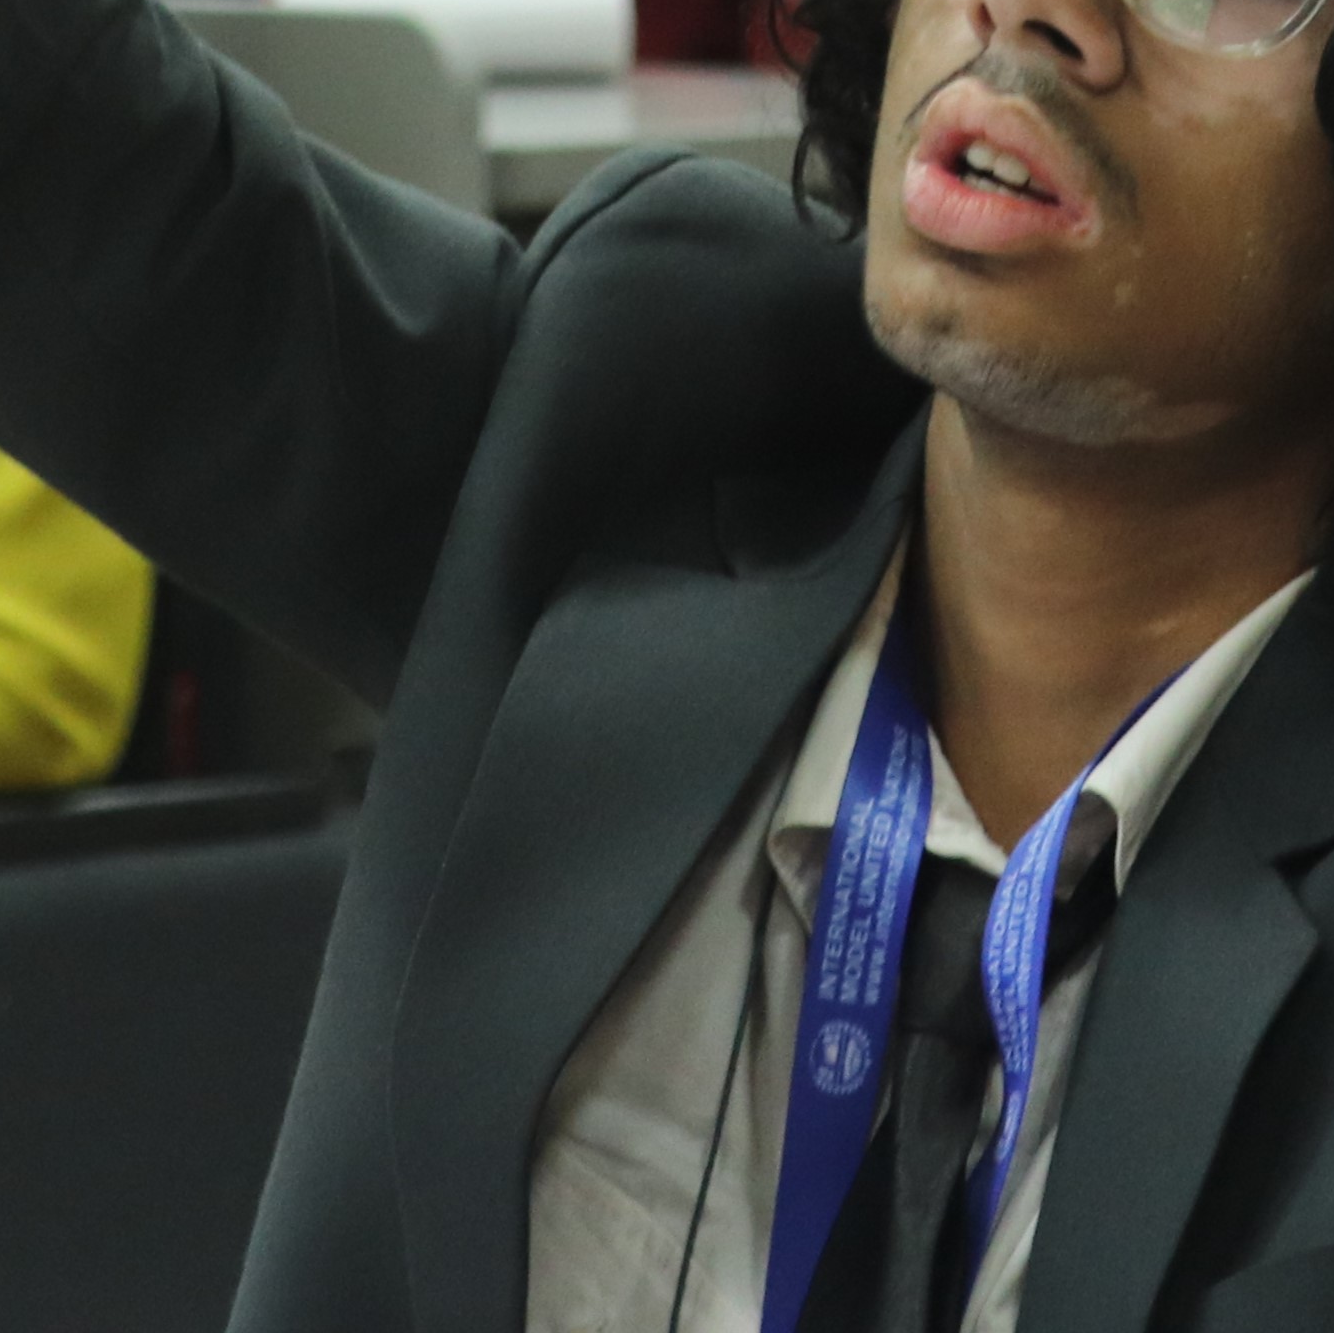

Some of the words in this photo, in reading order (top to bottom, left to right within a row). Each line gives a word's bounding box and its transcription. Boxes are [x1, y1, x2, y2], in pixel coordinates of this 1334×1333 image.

[818, 796, 874, 1001] INTERNATIONAL
[839, 915, 872, 1004] MODEL
[857, 811, 894, 908] UNITED
[1002, 878, 1029, 976] UNITED
